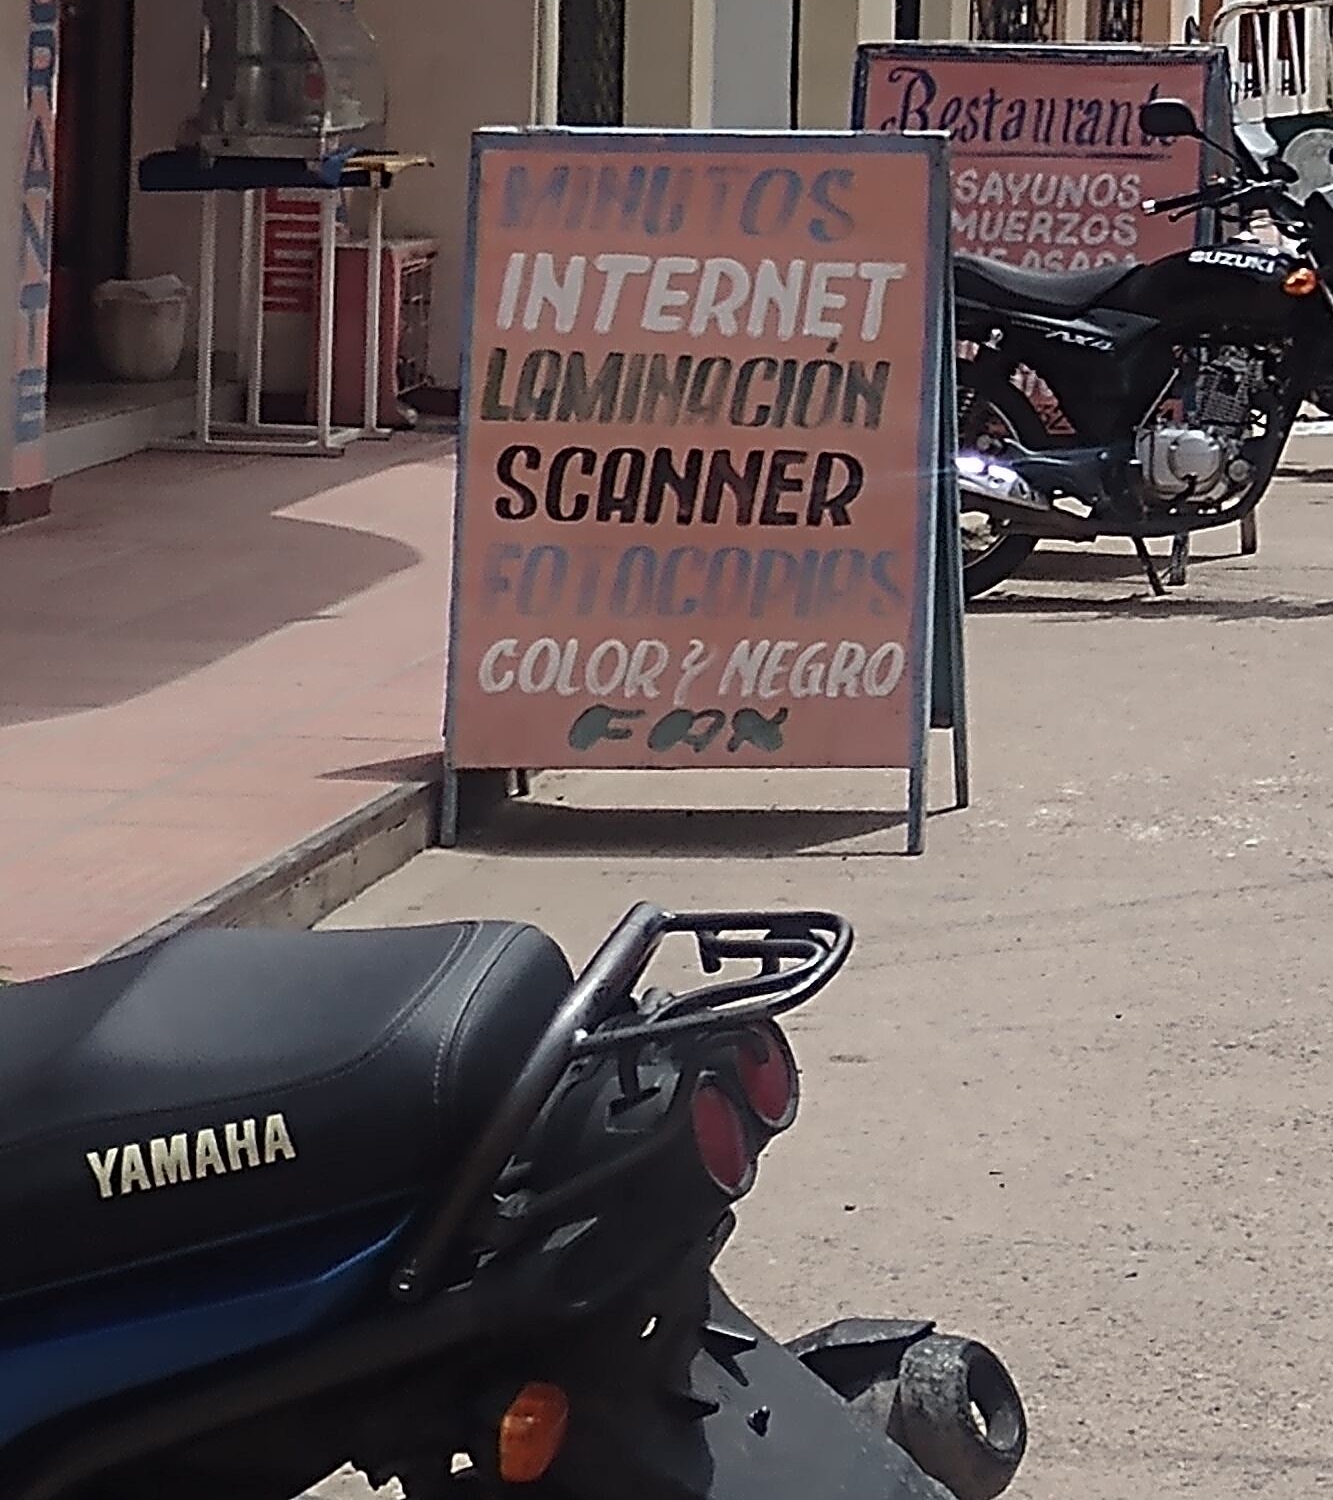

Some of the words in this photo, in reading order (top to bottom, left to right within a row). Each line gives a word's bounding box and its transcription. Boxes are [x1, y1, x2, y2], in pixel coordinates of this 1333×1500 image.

[500, 164, 856, 243] MINUTOS
[496, 252, 907, 342] INTERNET
[1187, 250, 1276, 274] SUZUKI
[480, 341, 891, 430] LAMINACIÓN
[494, 444, 865, 527] SCANNER
[477, 542, 906, 619] FOTOCOPIAS
[477, 637, 670, 699] COLOR
[718, 638, 906, 699] NEGRO
[568, 703, 789, 754] FAX
[86, 1112, 297, 1198] YAMAHA
